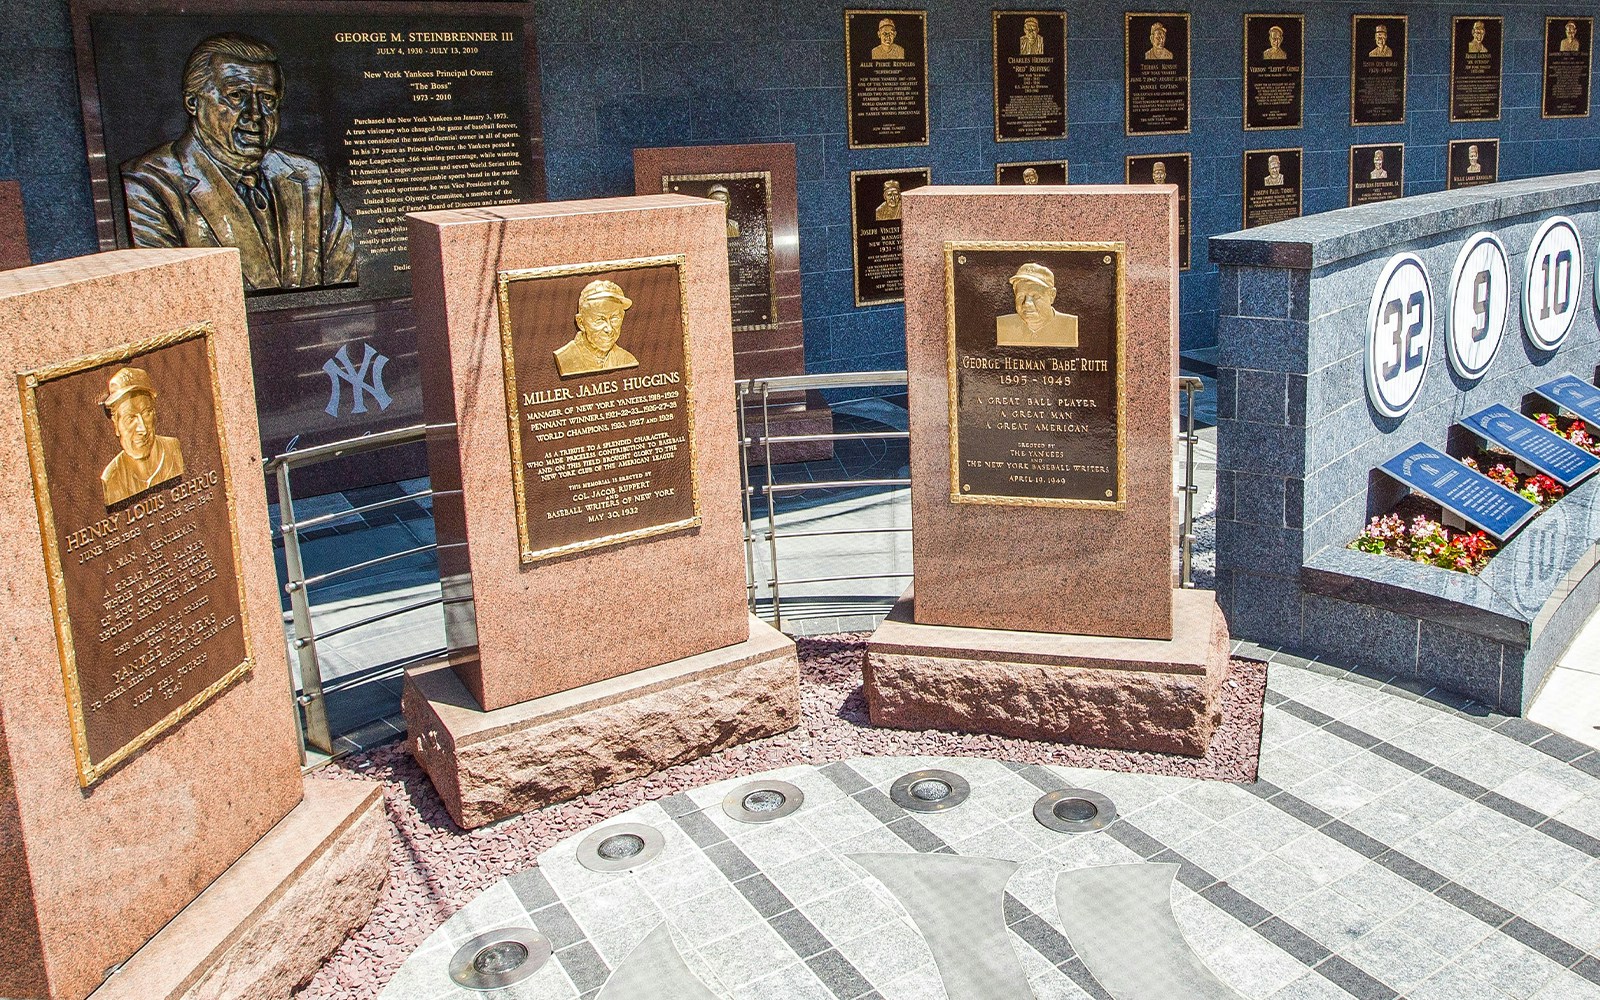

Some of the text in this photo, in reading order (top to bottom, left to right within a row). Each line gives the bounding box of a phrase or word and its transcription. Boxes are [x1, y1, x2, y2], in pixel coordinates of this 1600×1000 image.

[335, 32, 513, 42] GEORGE M. STEINBRENNER III
[436, 70, 468, 79] Principal
[367, 128, 395, 136] visionary
[411, 126, 435, 134] changed
[447, 125, 462, 133] game
[1540, 249, 1571, 321] 10
[1472, 270, 1491, 342] 9
[1383, 291, 1424, 381] 32
[962, 356, 1001, 369] GEORGE
[1005, 358, 1046, 370] HERMAN
[1080, 359, 1108, 371] RUTH
[322, 343, 393, 417] NY
[523, 372, 680, 406] MILLER JAMES HUGGINS
[1000, 376, 1027, 385] 1895
[1043, 376, 1071, 386] 1948
[527, 409, 562, 421] MANAGER
[576, 404, 593, 413] NEW
[596, 401, 614, 410] YORK
[1058, 399, 1097, 407] PLAYER
[531, 420, 566, 431] PENNANT
[536, 432, 564, 442] WORLD
[629, 418, 644, 427] 1927
[1034, 424, 1089, 432] AMERICAN
[560, 446, 584, 456] TRIBUTE
[603, 439, 631, 449] SPLENDID
[634, 432, 669, 444] CHARACTER
[541, 473, 556, 481] NEW
[558, 471, 576, 479] YORK
[618, 457, 649, 468] AMERICAN
[652, 453, 674, 463] LEAGUE
[592, 488, 616, 498] JACOB
[618, 481, 650, 493] RUPPERT
[65, 470, 218, 552] HENRY LOUIS GEHRIG
[547, 507, 582, 519] BASEBALL
[585, 500, 620, 512] WRITERS
[634, 493, 651, 502] NEW
[654, 488, 674, 498] YORK
[588, 515, 604, 523] MAY
[622, 507, 638, 516] 1932
[79, 546, 103, 564] JUNE
[160, 508, 183, 524] JUNE
[115, 540, 204, 591] GREAT BALL PLAYER
[112, 612, 217, 684] YANKEE PLAYERS
[132, 653, 208, 708] JULY THE FOURTH
